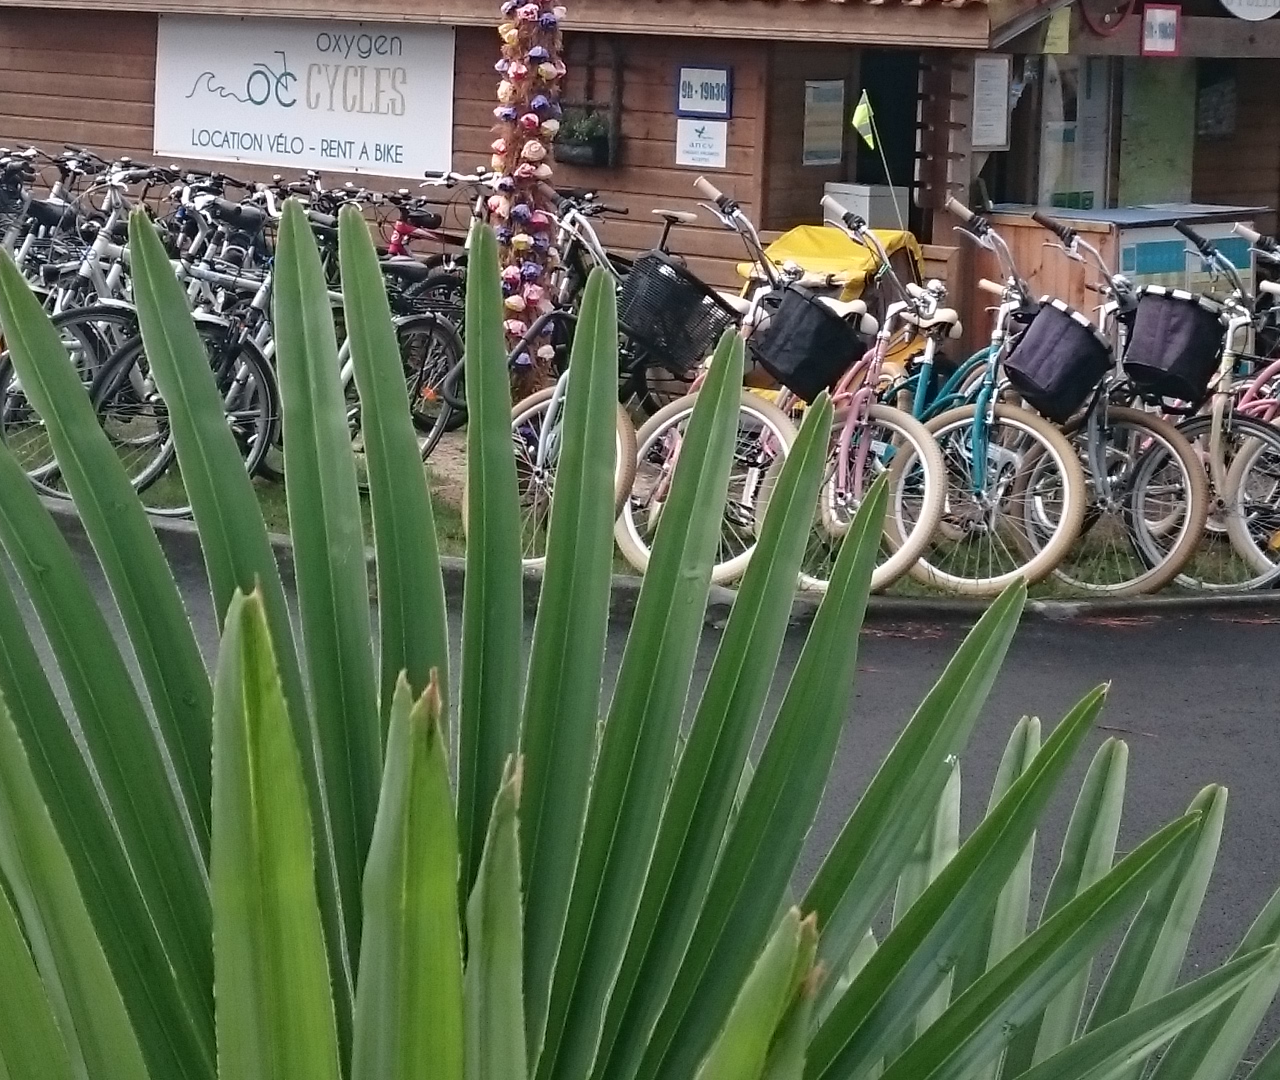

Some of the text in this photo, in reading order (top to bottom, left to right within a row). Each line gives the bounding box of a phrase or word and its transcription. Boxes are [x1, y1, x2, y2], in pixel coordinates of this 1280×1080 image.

[316, 32, 402, 59] oxygen
[306, 63, 407, 116] CYCLES
[191, 128, 262, 152] LOCATION
[267, 132, 304, 155] VÉLO
[321, 139, 355, 159] RENT
[359, 142, 369, 161] A
[375, 143, 403, 164] BIKE
